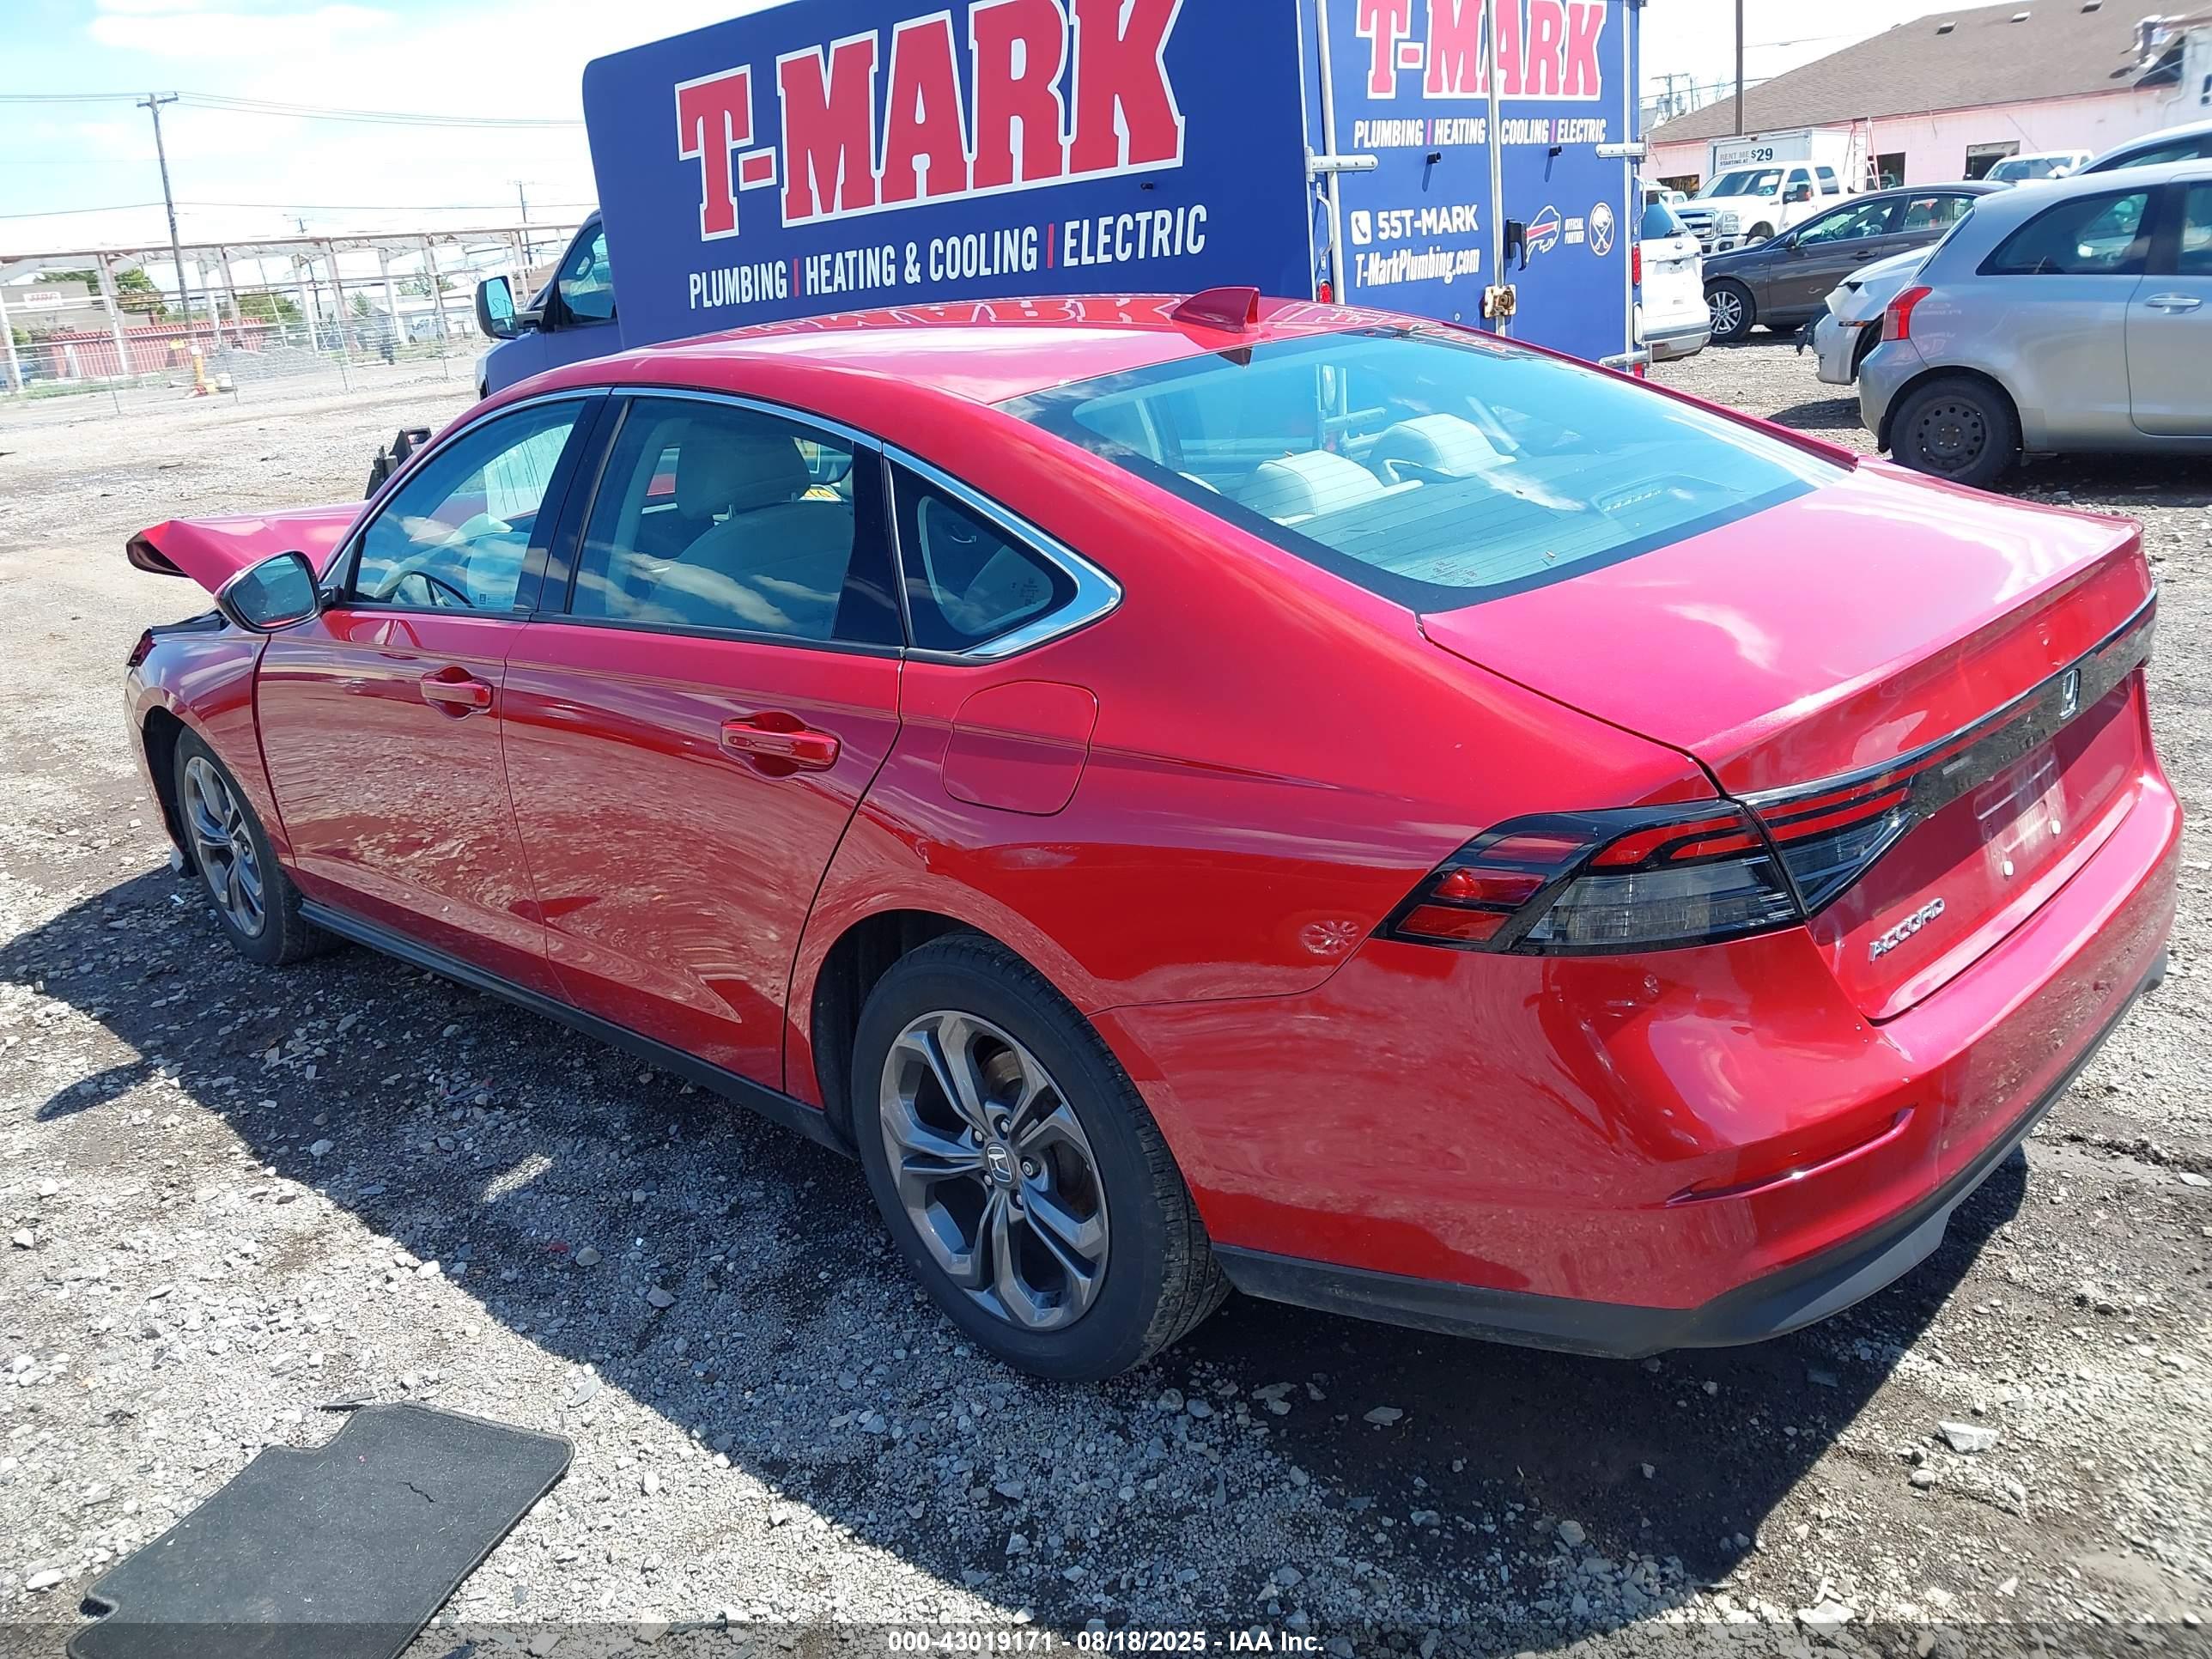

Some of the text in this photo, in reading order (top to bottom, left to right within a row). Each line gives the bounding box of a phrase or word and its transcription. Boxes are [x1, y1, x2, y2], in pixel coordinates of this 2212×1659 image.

[1355, 0, 1607, 101] T-MARK
[675, 0, 1185, 242] T-MARK
[1353, 118, 1424, 149] PLUMBING
[1434, 118, 1486, 145] HEATING
[1500, 118, 1549, 145] COOLING
[1557, 118, 1607, 143] ELECTRIC
[1720, 152, 1737, 161] RENT
[1751, 148, 1773, 161] $29
[1377, 204, 1480, 240] 55T-MARK
[690, 204, 1208, 310] PLUMBING HEATING & COOLING ELECTRIC
[1355, 245, 1480, 288] T-MarkPlumbing.com
[1869, 896, 1946, 962] ACCORD
